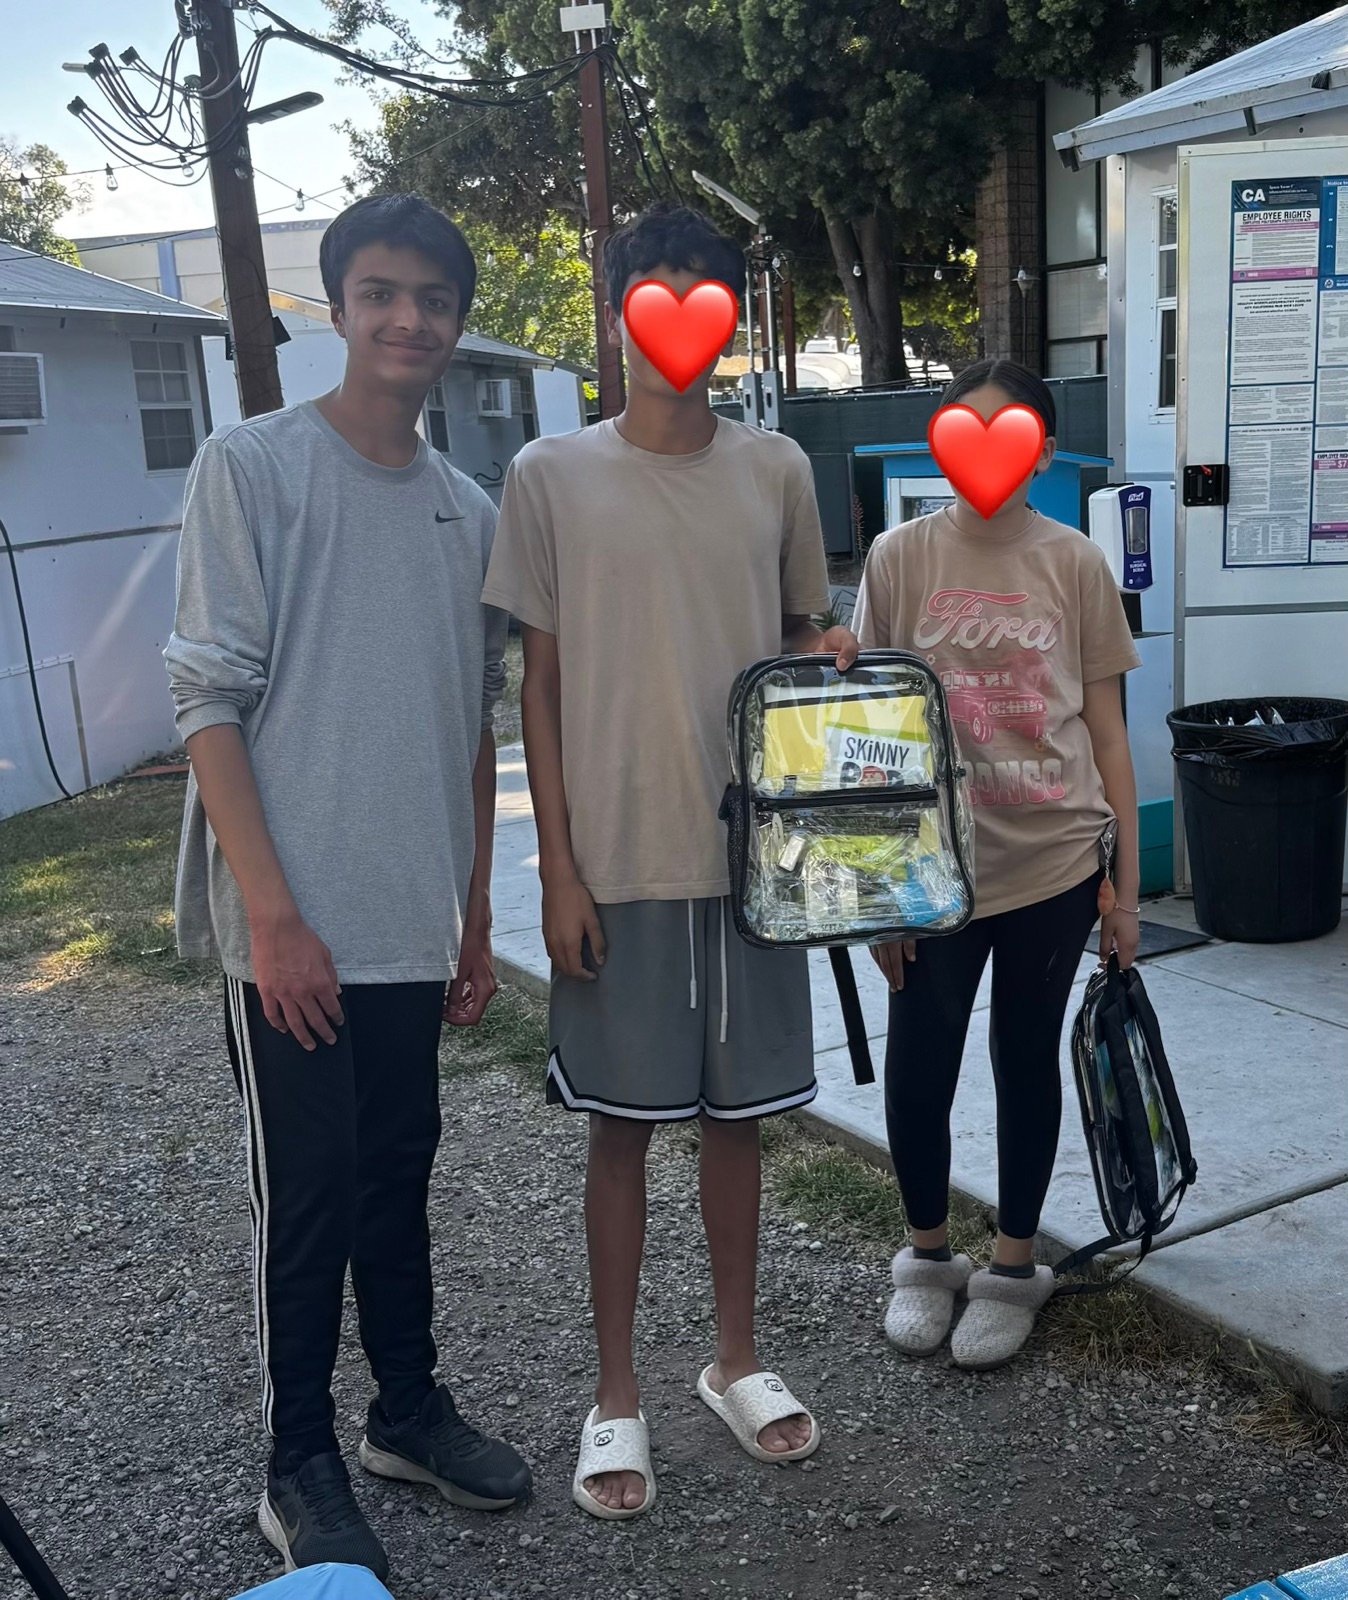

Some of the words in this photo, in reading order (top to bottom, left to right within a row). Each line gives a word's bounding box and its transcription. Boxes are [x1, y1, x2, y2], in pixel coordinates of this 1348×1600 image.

[1241, 188, 1266, 203] CA
[1242, 211, 1282, 221] EMPLOYEE
[1284, 210, 1312, 219] RIGHTS
[913, 588, 1063, 651] Ford
